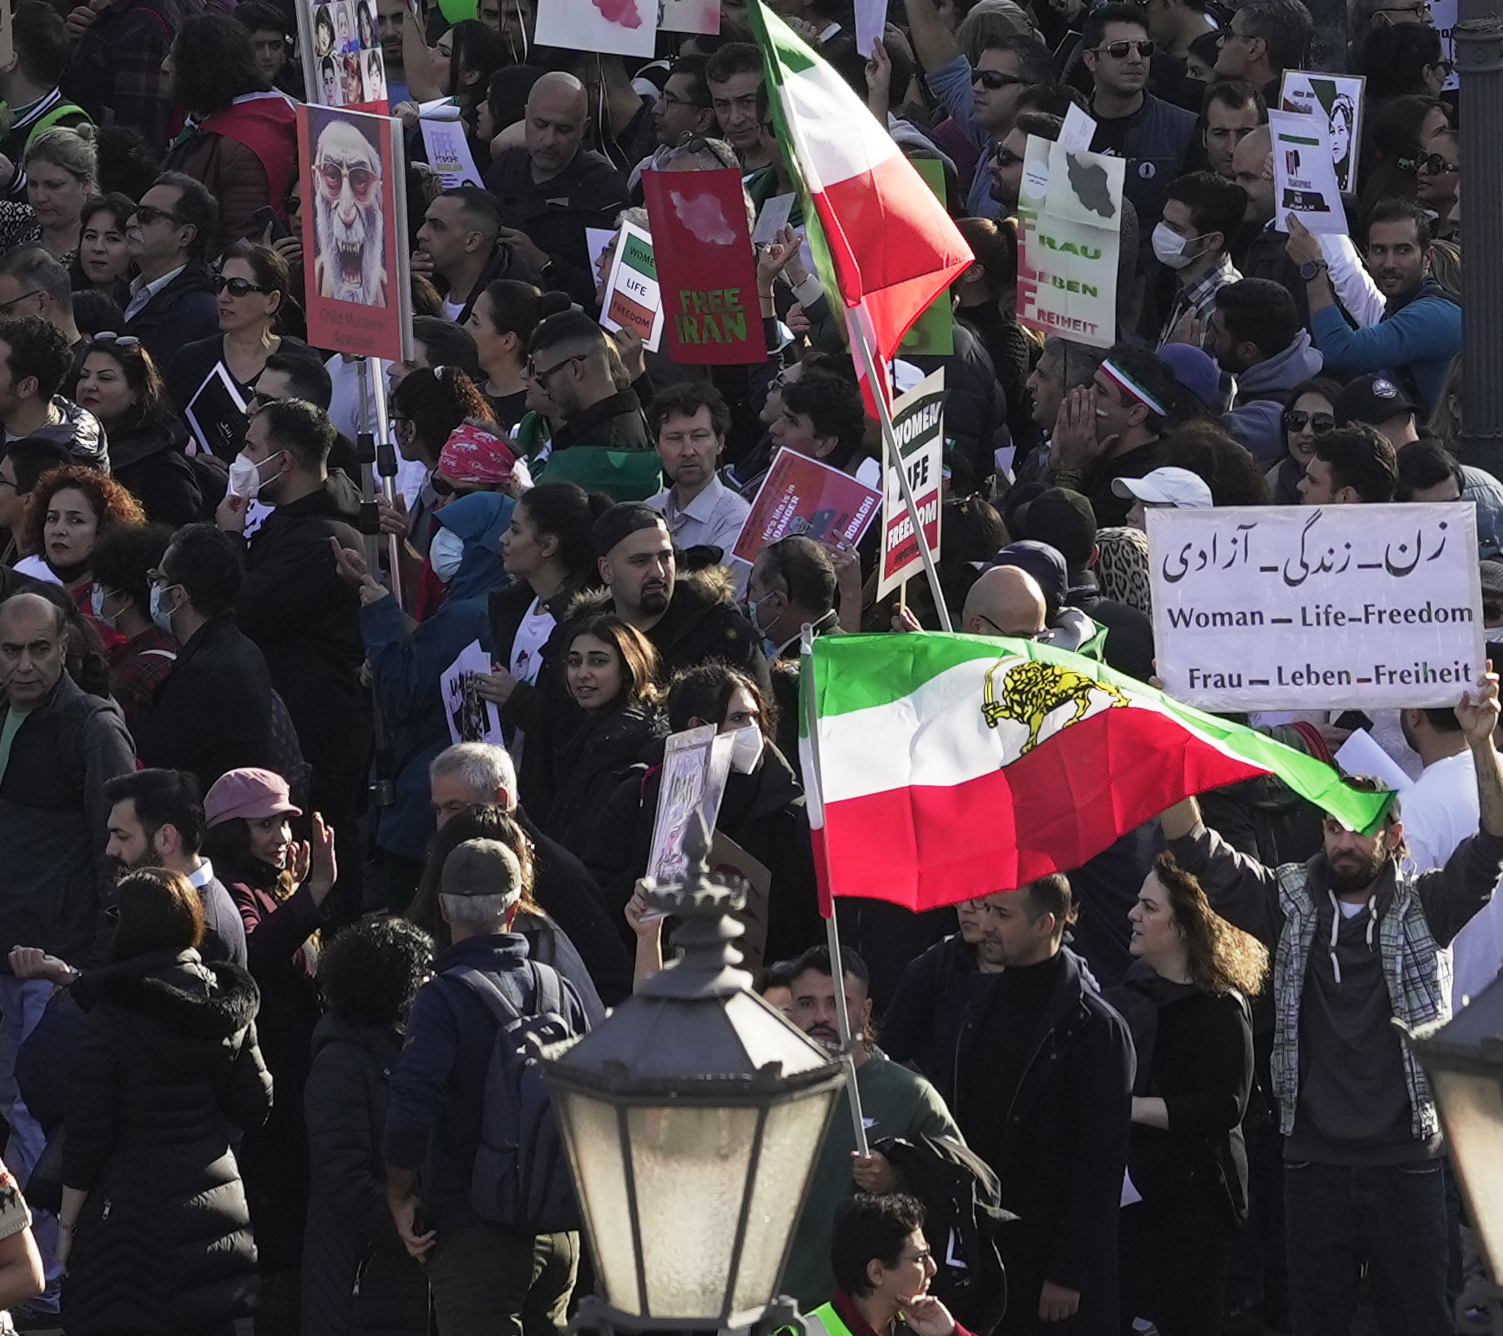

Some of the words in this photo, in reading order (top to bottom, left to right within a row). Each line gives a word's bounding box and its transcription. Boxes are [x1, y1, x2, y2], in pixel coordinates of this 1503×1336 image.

[679, 287, 744, 314] FREE
[674, 311, 748, 345] IRAN
[1166, 603, 1265, 630] Woman
[1187, 666, 1244, 689] Frau
[1276, 664, 1351, 686] Leben
